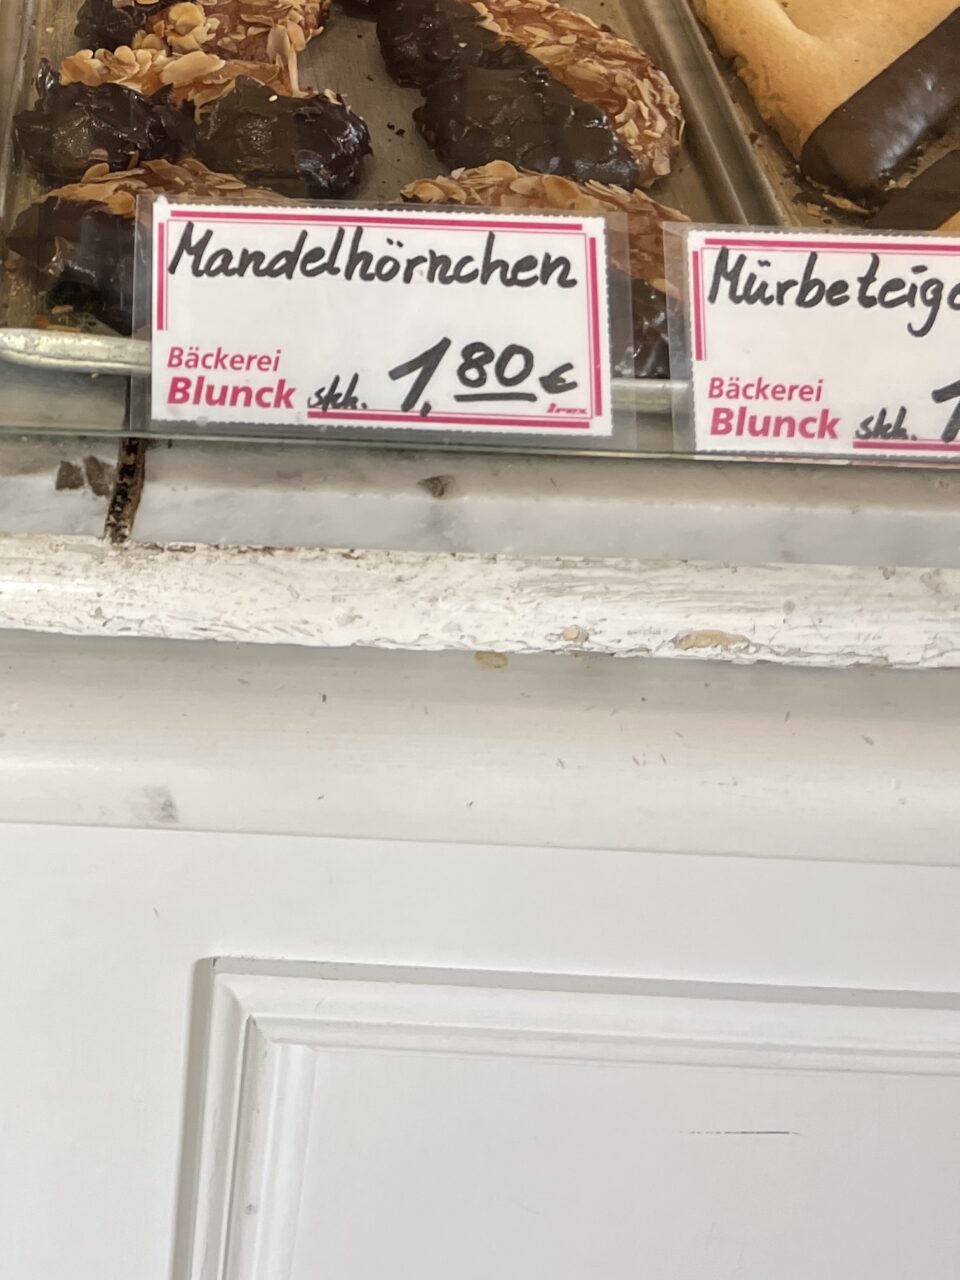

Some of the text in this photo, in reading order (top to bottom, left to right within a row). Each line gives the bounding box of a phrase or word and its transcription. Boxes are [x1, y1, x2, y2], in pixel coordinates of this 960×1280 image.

[168, 221, 578, 288] Mandelhörnchen
[166, 347, 282, 372] Bäckerei
[166, 376, 296, 409] Blunck
[708, 377, 824, 402] Bäckerei
[710, 406, 841, 440] Blunck
